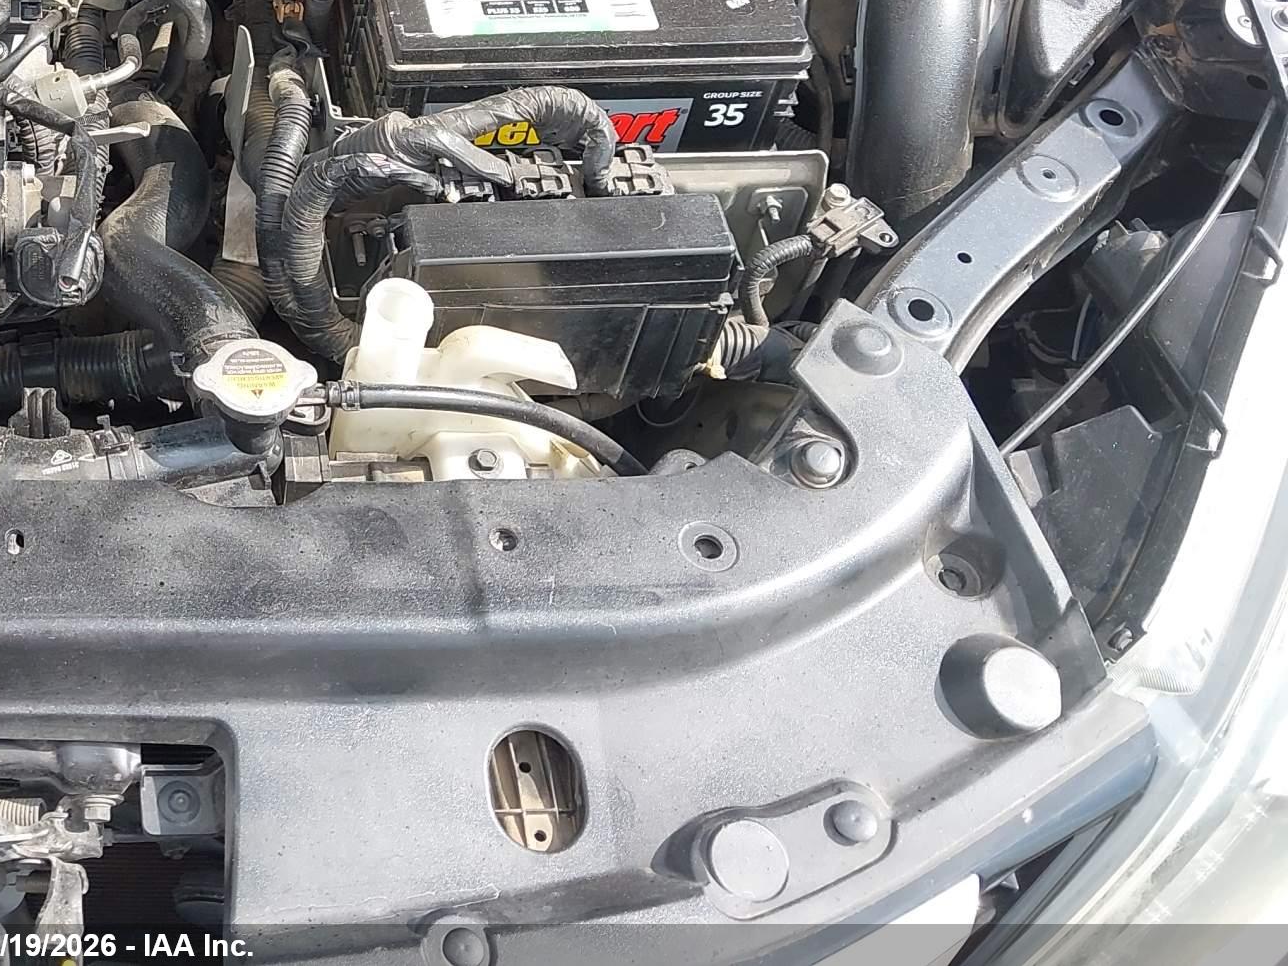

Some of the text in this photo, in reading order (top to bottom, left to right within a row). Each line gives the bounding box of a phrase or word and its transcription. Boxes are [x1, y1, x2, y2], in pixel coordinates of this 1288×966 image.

[703, 90, 763, 100] GROUP SIZE
[703, 103, 749, 127] 35
